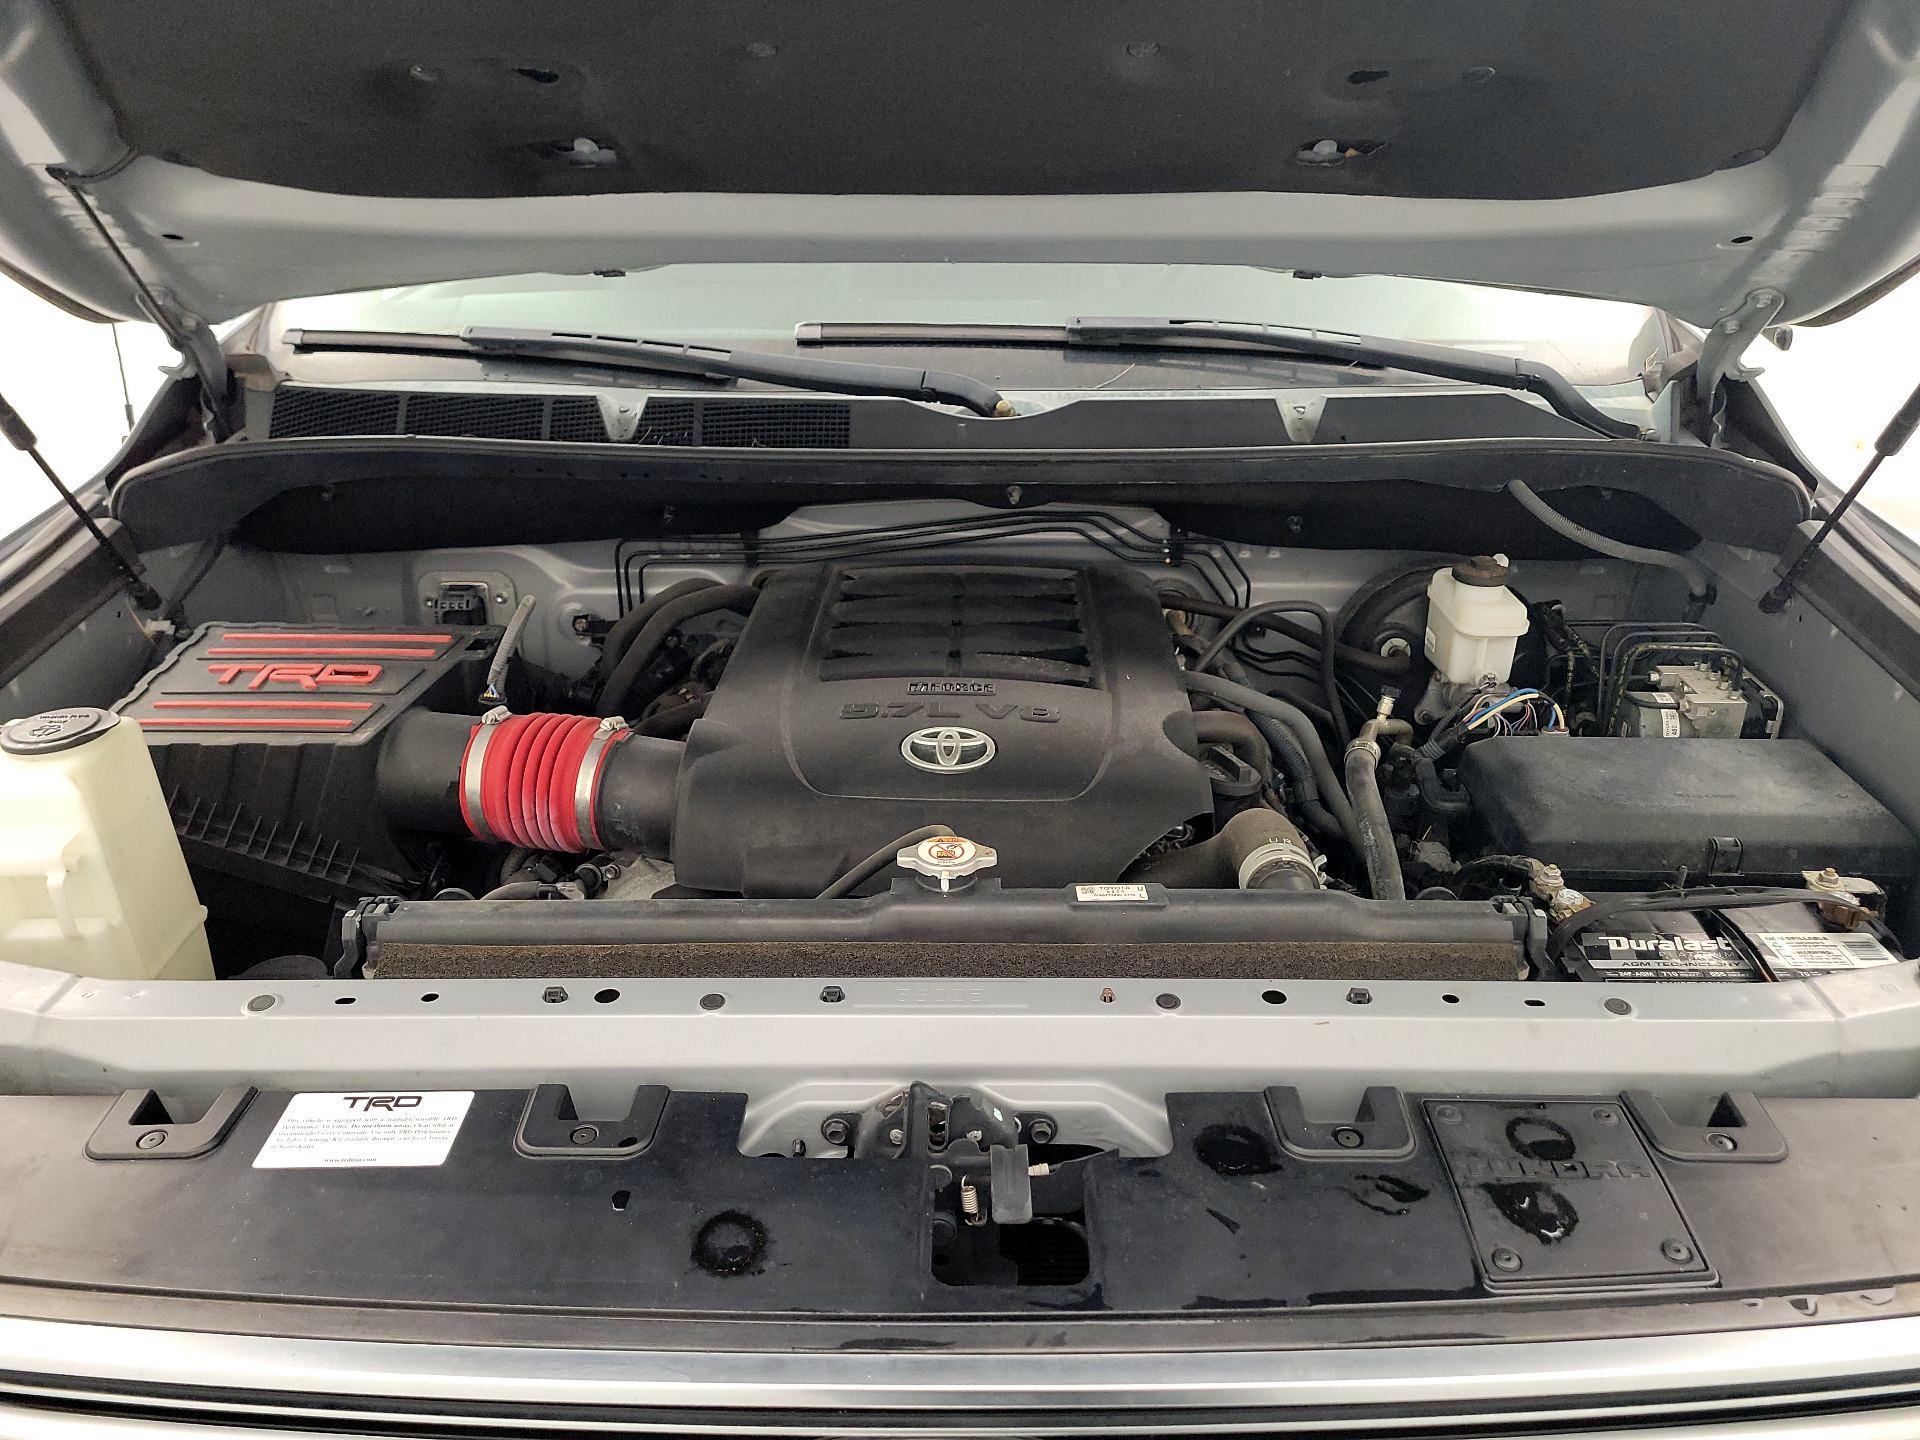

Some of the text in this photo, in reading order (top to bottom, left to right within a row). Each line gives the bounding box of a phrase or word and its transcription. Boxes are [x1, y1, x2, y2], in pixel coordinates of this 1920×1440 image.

[208, 664, 382, 690] TRD
[840, 701, 1060, 722] 5.7L V8
[1599, 936, 1733, 951] Duralast
[343, 1096, 422, 1112] TRD
